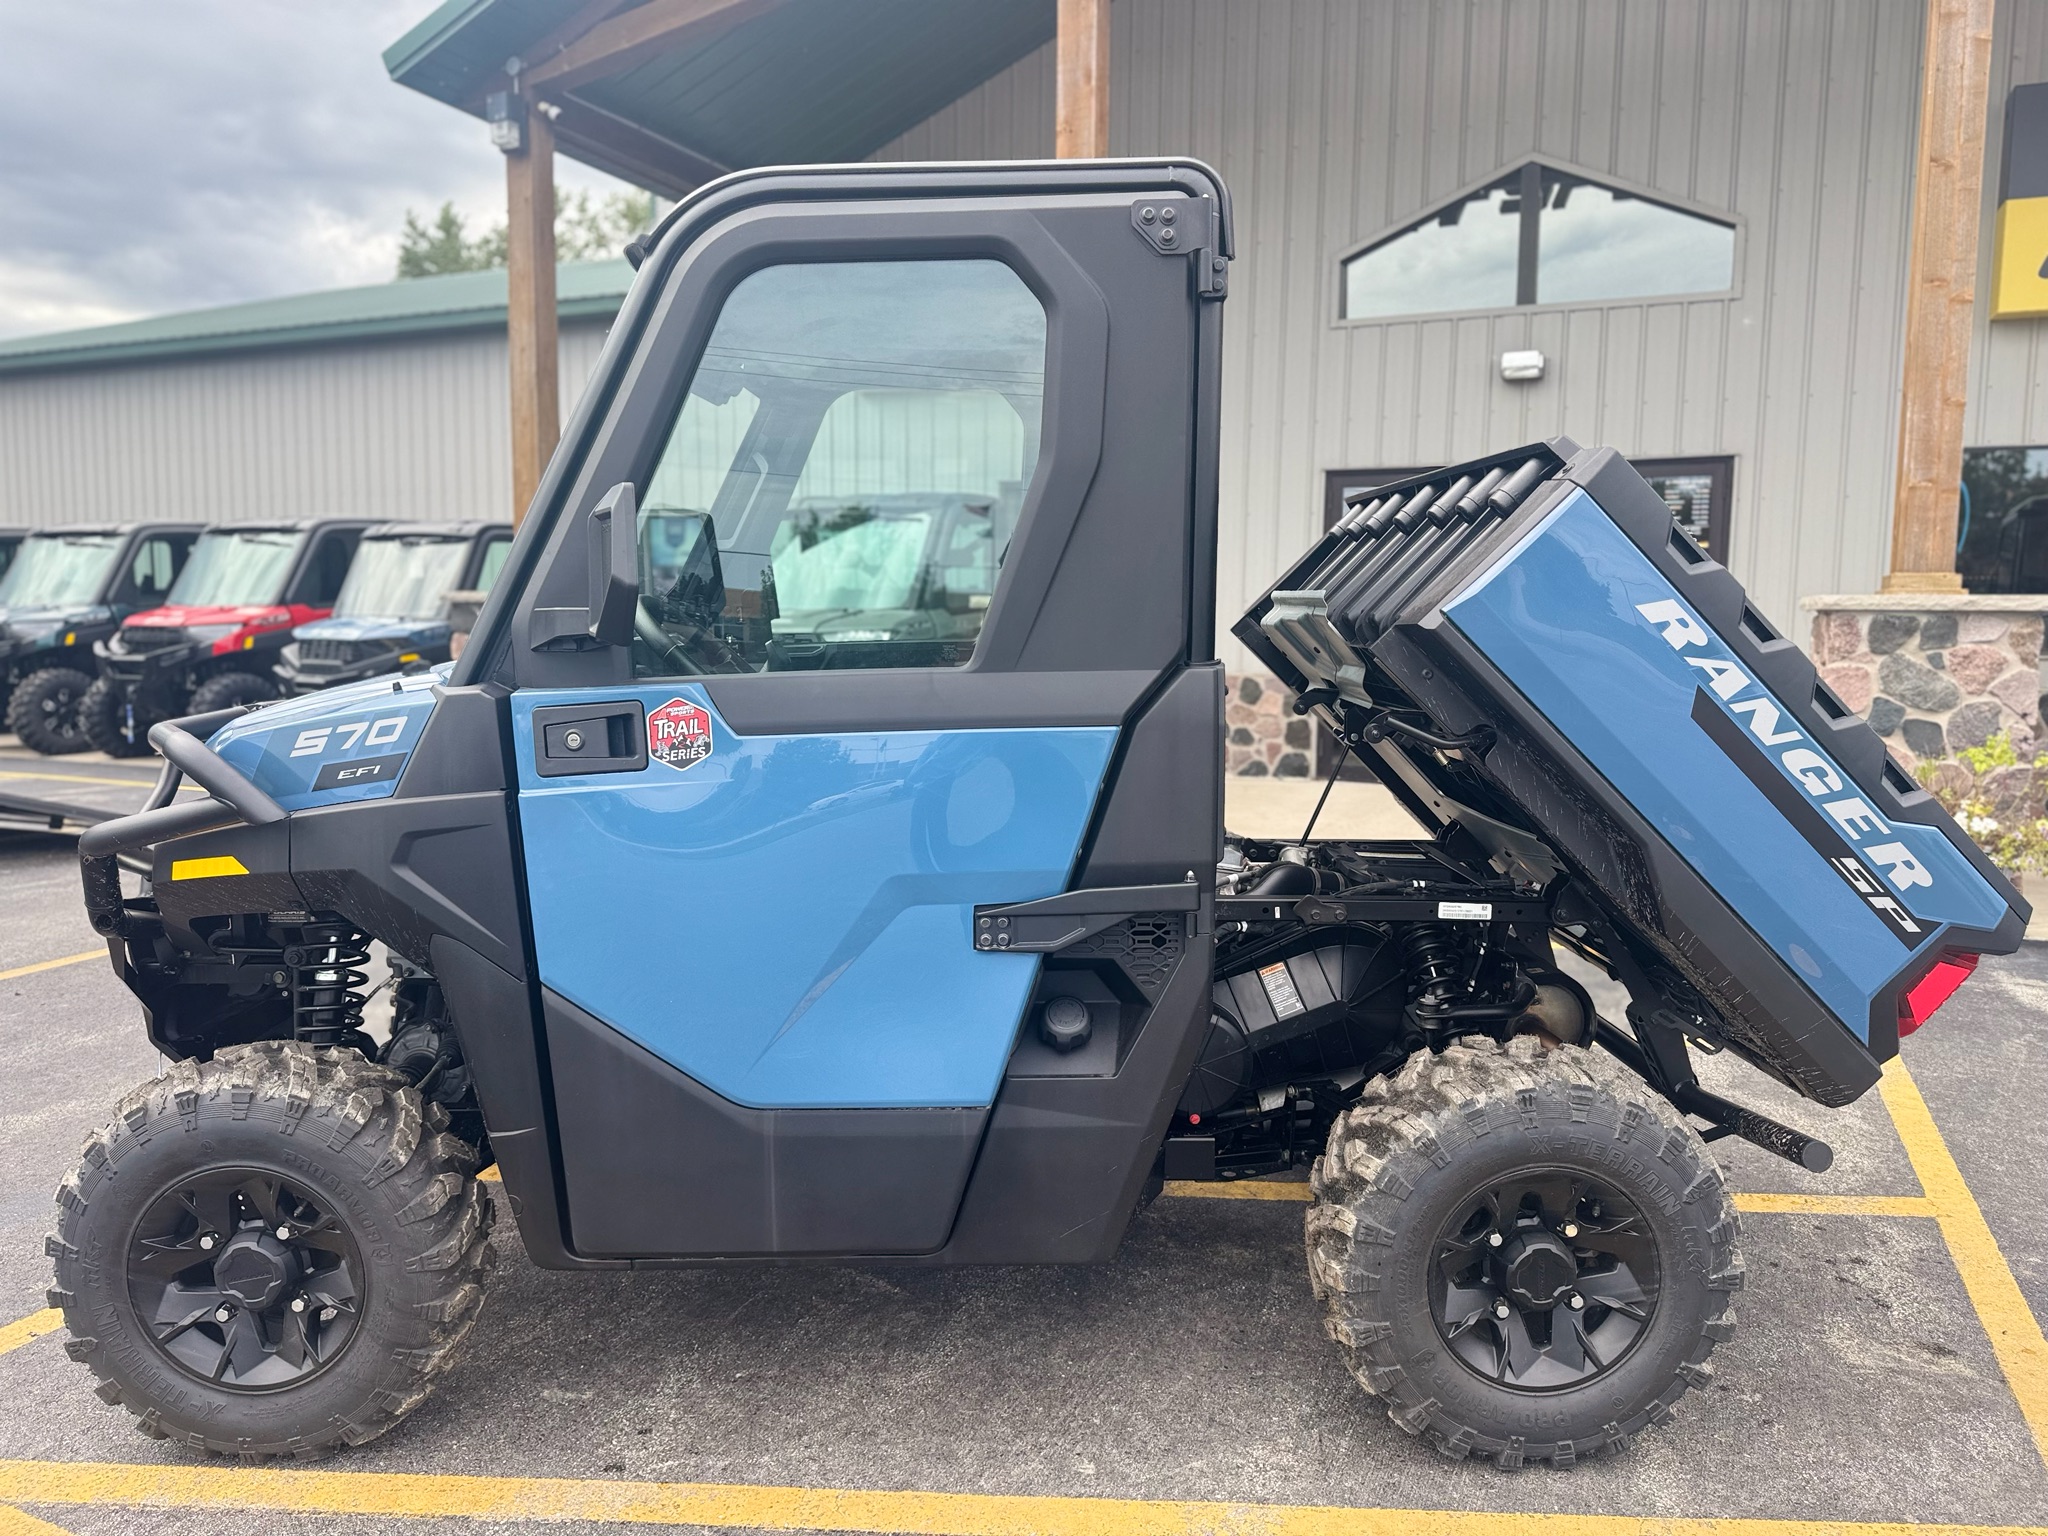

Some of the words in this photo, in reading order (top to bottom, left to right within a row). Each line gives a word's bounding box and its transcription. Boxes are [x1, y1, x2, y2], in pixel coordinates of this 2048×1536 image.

[289, 715, 408, 758] 570
[653, 718, 705, 740] TRAIL
[662, 746, 706, 762] SERIES
[1635, 598, 1933, 892] RANGER
[337, 765, 381, 780] EFI
[1831, 856, 1922, 935] SP
[1529, 1134, 1682, 1218] X-TERRAIN
[91, 1302, 227, 1425] X-TERRAIN
